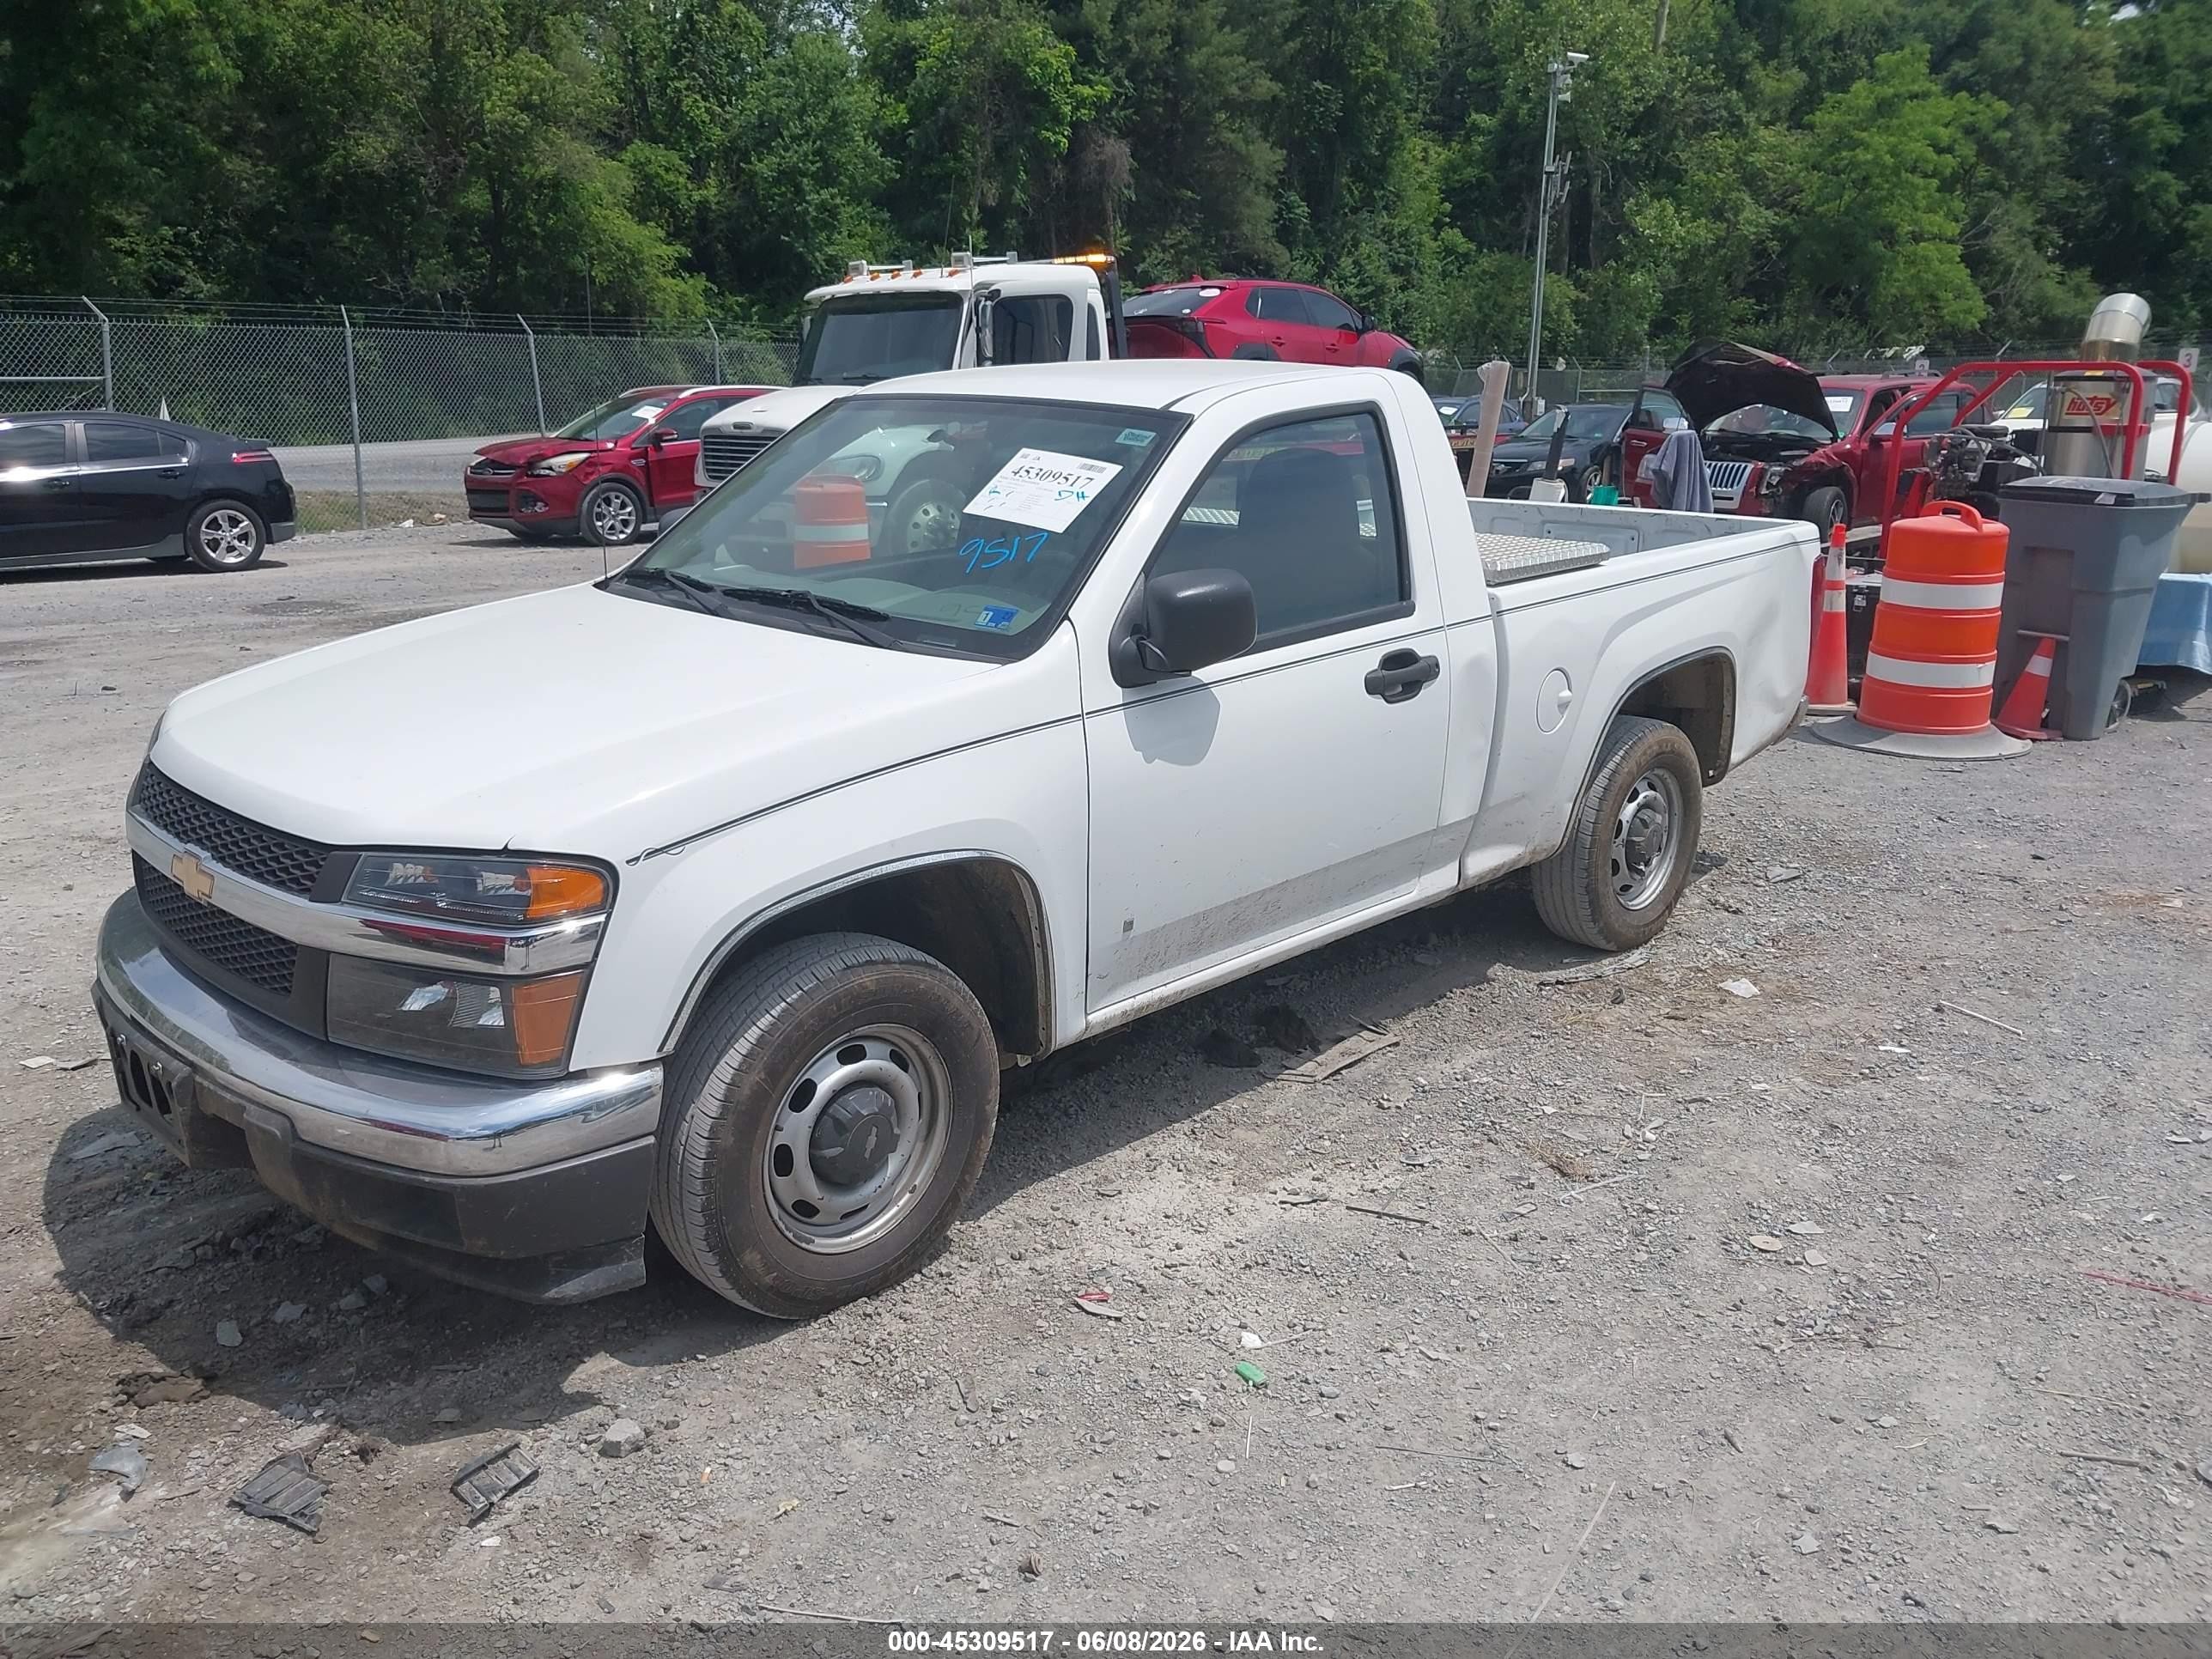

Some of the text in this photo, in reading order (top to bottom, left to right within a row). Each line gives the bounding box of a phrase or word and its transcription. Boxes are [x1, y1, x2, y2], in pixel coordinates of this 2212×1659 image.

[2183, 352, 2192, 368] 3
[1011, 465, 1096, 489] 45309517
[958, 531, 1049, 574] 9517
